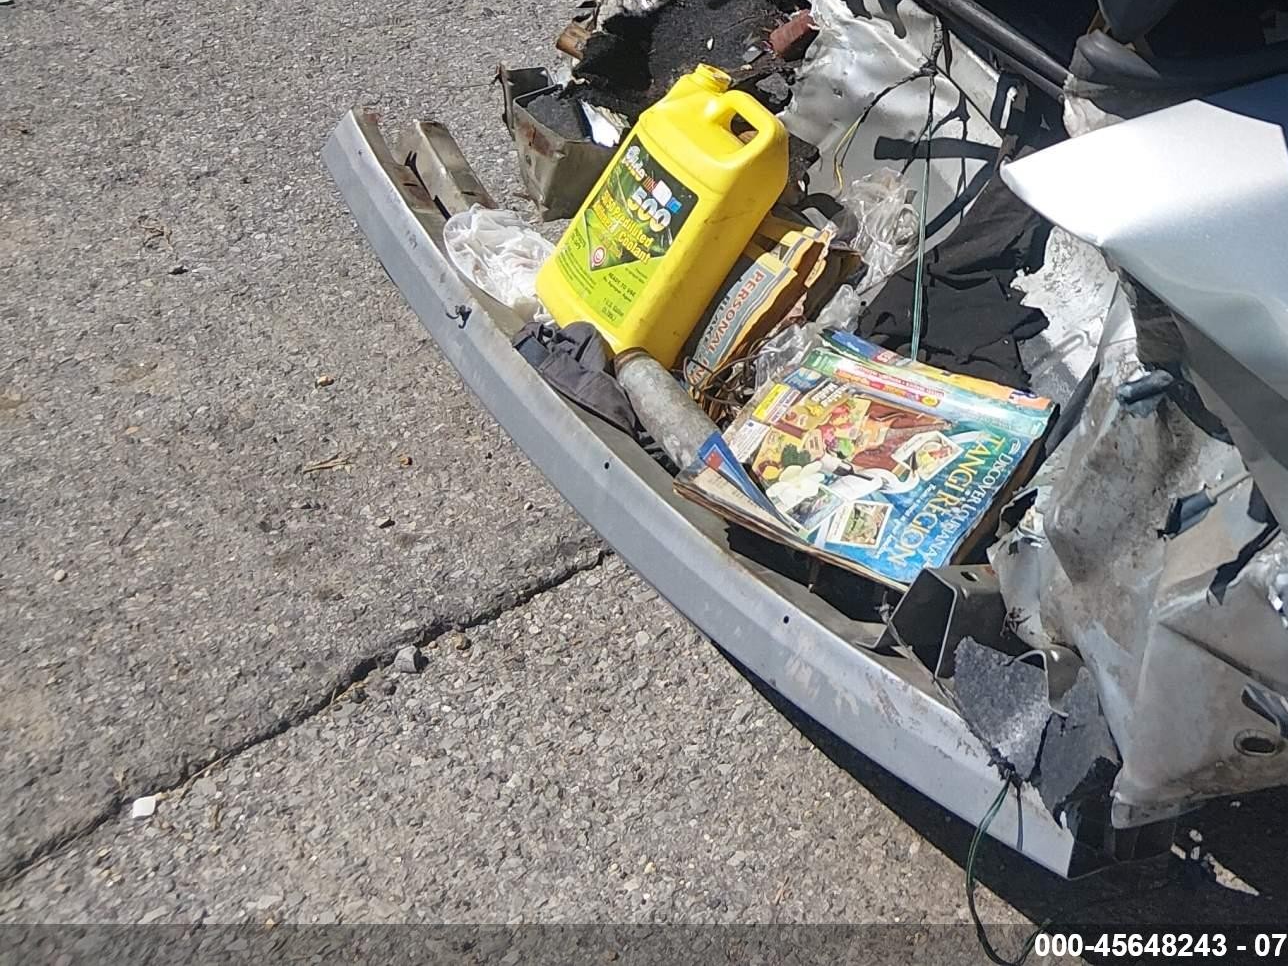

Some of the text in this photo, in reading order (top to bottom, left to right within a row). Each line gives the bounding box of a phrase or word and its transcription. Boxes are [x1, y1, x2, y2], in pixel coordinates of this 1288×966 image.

[614, 206, 654, 249] Prediluted
[627, 185, 671, 232] 500
[618, 231, 651, 265] Coolant
[707, 270, 765, 353] PERSONAL
[944, 435, 1006, 497] TANGI
[886, 488, 959, 567] REGION
[925, 452, 1013, 557] DISCOVER LOUISIANA
